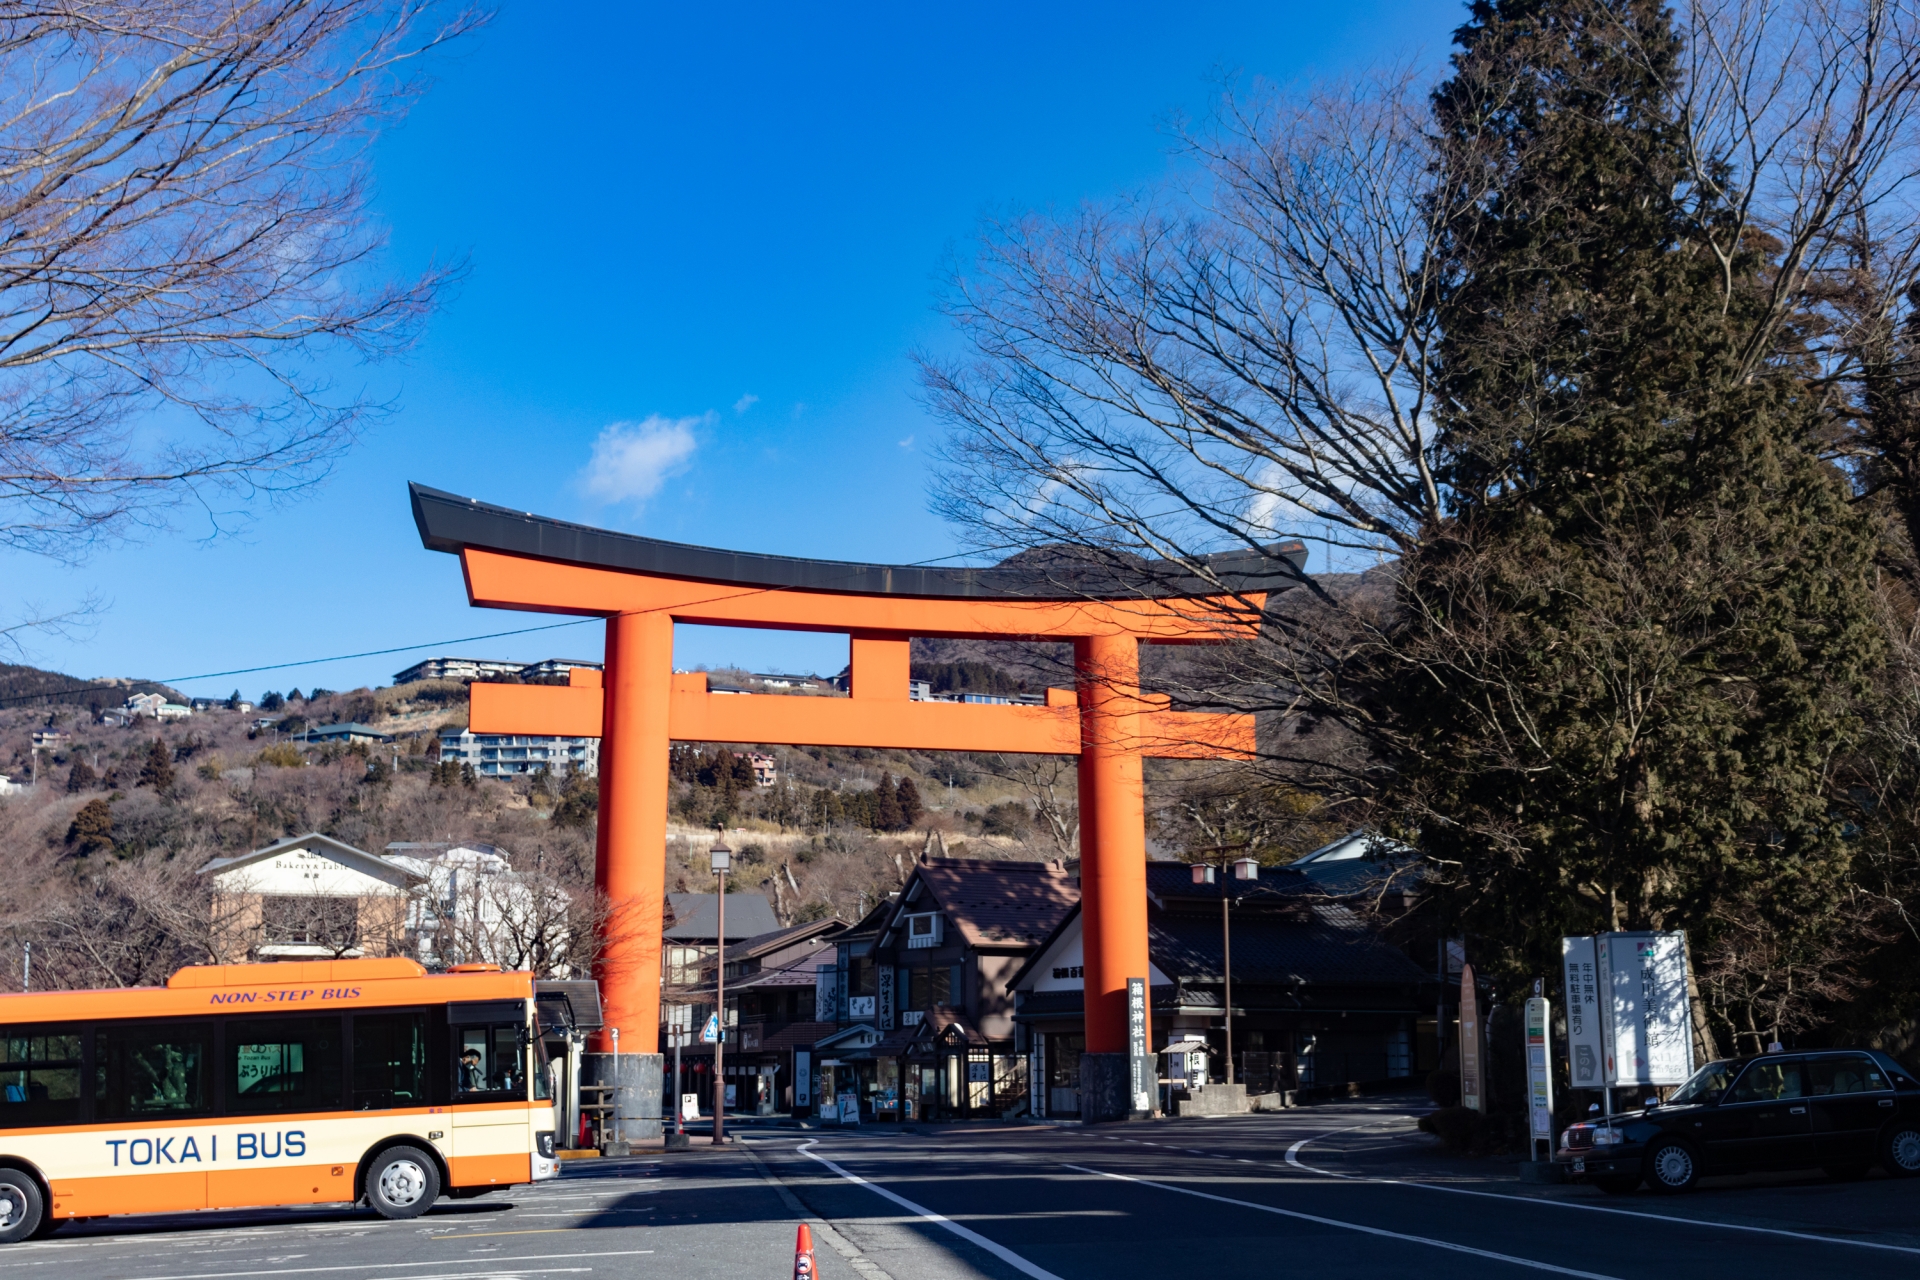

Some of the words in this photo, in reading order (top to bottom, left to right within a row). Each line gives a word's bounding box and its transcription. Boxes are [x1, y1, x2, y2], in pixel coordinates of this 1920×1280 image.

[275, 860, 310, 870] Bakery
[321, 861, 350, 871] Table
[209, 989, 315, 1005] NON-STEP
[321, 986, 362, 1000] BUS
[1534, 979, 1541, 994] 6
[1582, 962, 1595, 1005] 年中無休
[1131, 982, 1145, 1038] 箱根神社
[1568, 963, 1583, 1036] 無料駐車場有り
[1639, 966, 1659, 1048] 成川美術館
[611, 1028, 619, 1038] 2
[675, 1025, 681, 1034] 1
[1579, 1047, 1591, 1078] この角
[105, 1134, 217, 1167] TOKAI
[237, 1130, 307, 1160] BUS
